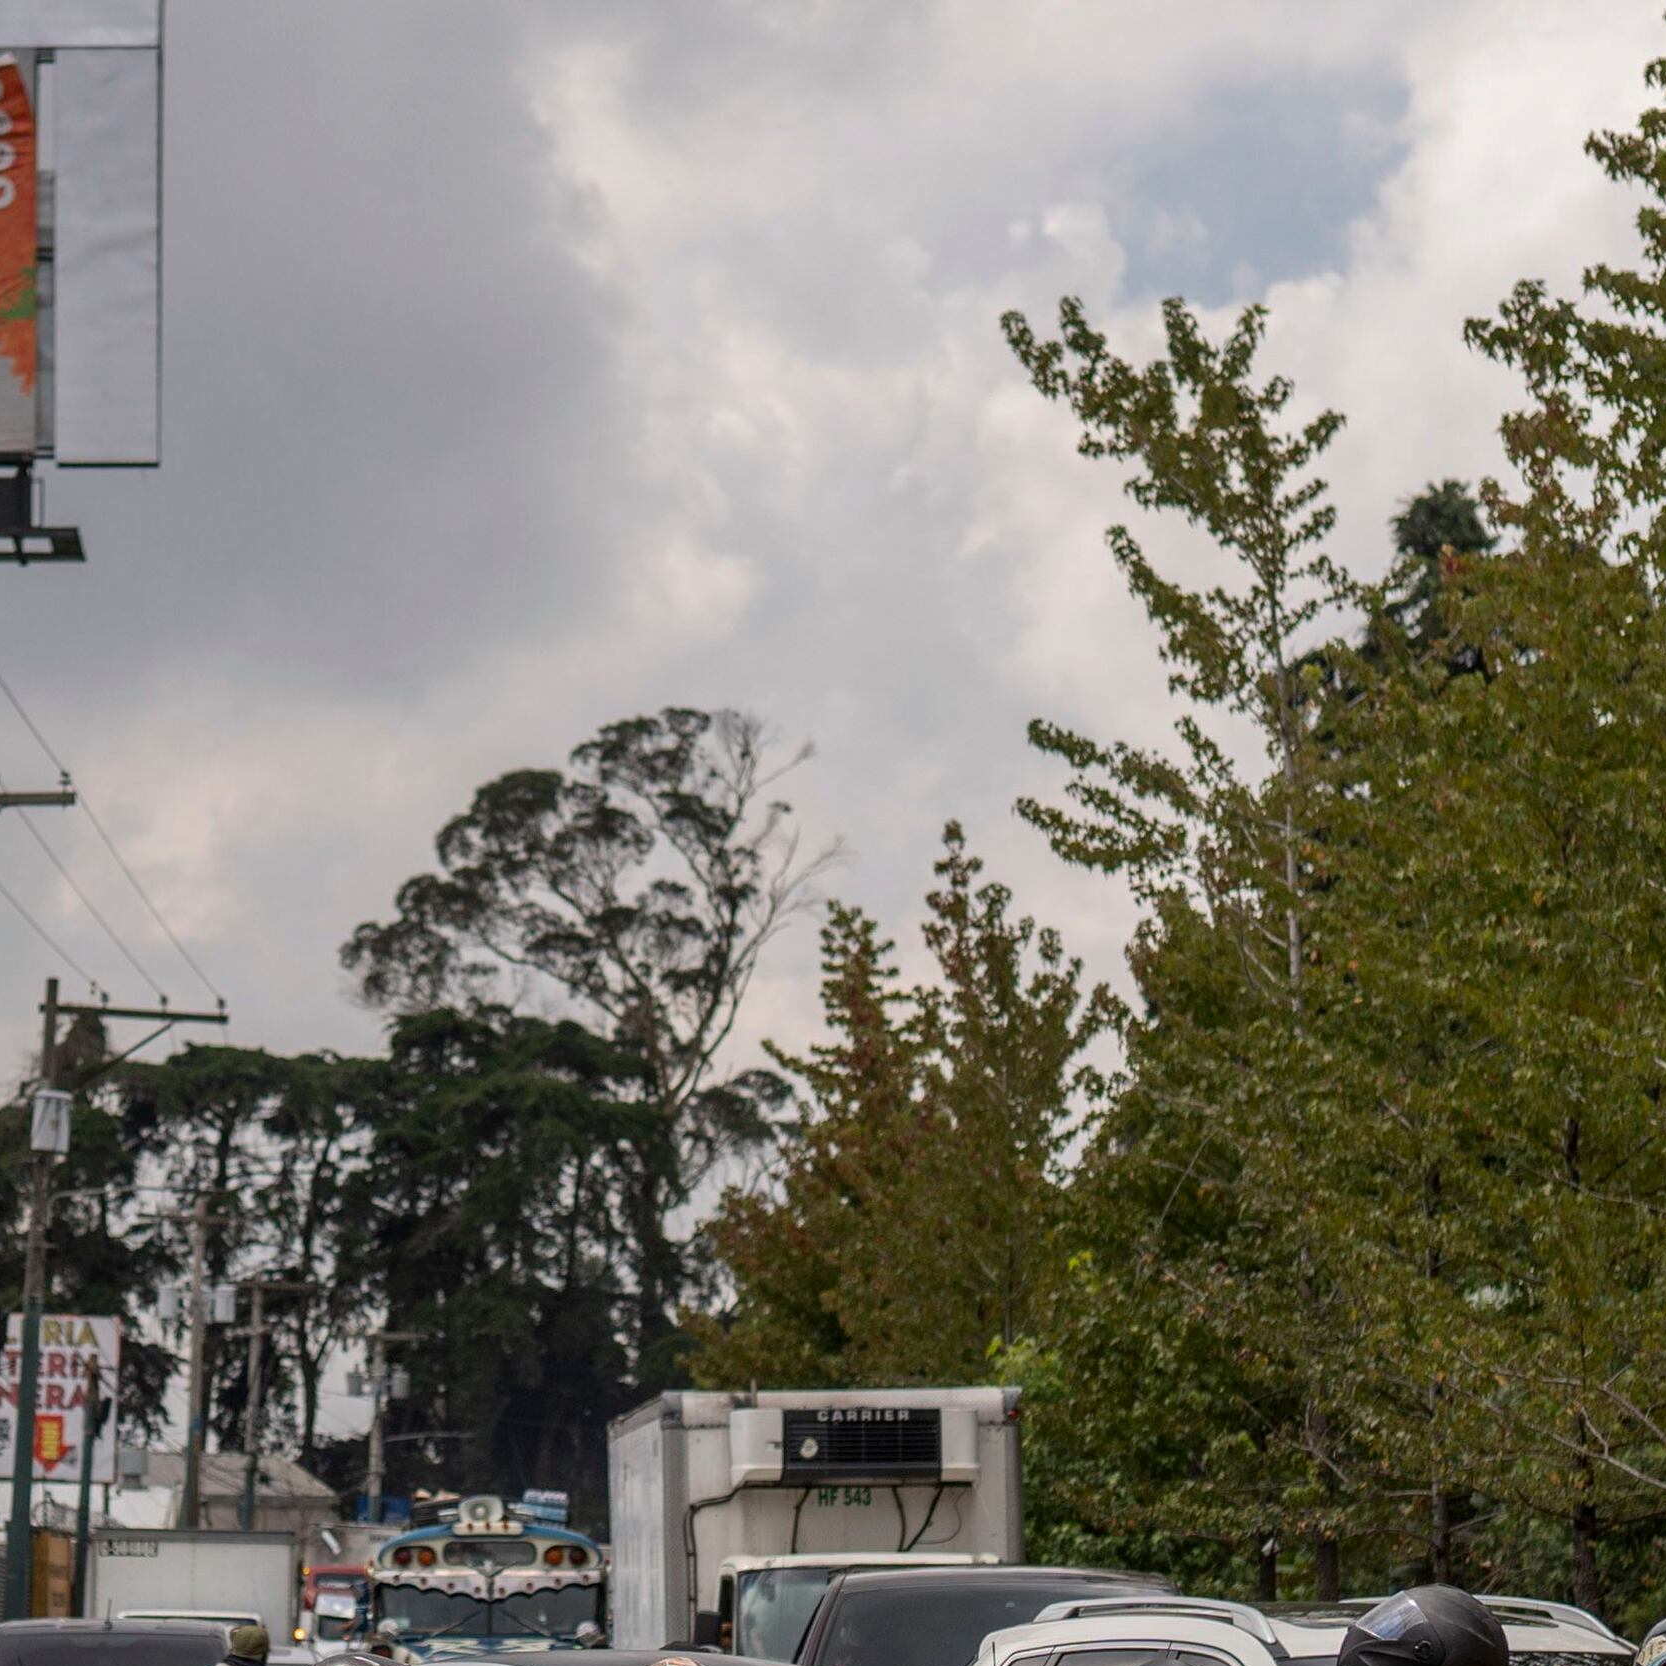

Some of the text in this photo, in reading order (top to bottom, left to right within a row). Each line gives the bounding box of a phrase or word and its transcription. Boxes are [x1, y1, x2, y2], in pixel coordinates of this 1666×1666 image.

[817, 1410, 910, 1422] CARRIER
[818, 1487, 873, 1507] HF 543
